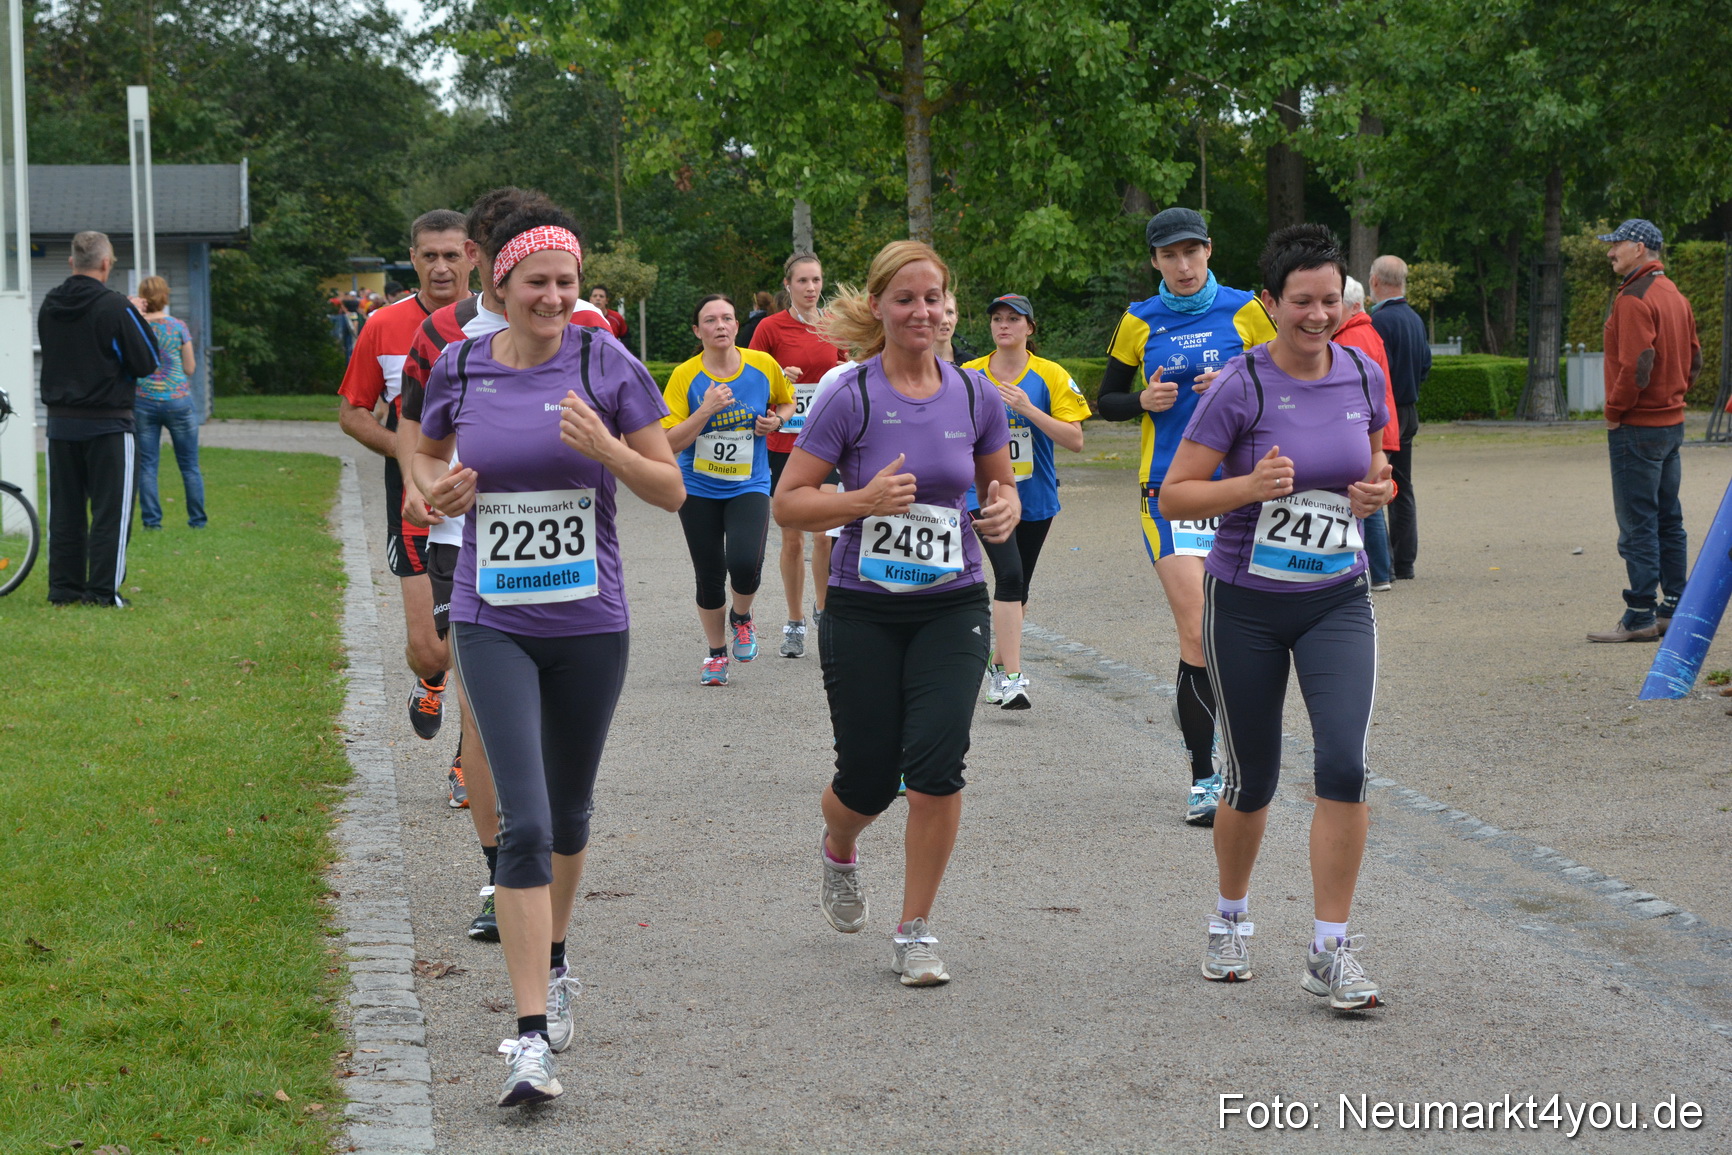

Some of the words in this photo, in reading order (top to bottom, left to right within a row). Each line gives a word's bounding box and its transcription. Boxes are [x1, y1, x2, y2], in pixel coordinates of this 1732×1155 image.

[1178, 337, 1208, 346] LANGE
[1202, 348, 1220, 363] FR
[1346, 411, 1361, 421] Anita
[713, 442, 738, 462] 92
[708, 462, 737, 474] Daniela
[479, 504, 515, 515] PARTL
[517, 500, 574, 514] Neumarkt
[1301, 497, 1345, 514] Neumarkt
[902, 511, 947, 526] Neumarkt
[1267, 507, 1349, 549] 2477
[489, 515, 585, 562] 2233
[872, 521, 951, 563] 2481
[1287, 554, 1324, 571] Anita
[496, 569, 581, 590] Bernadette
[885, 564, 937, 583] Kristina
